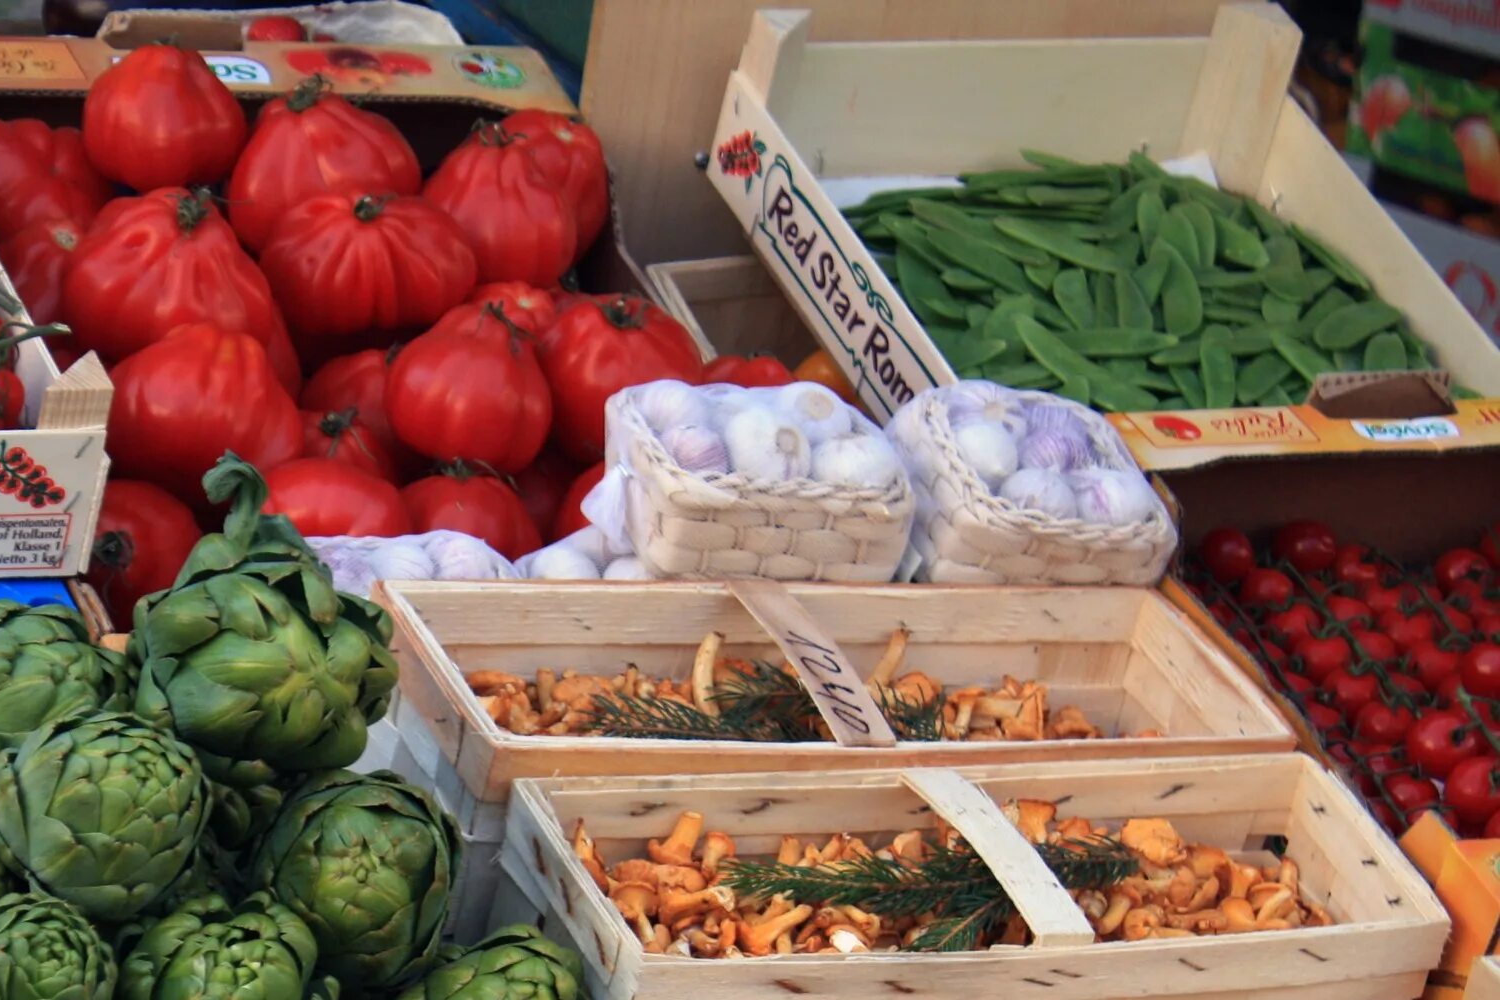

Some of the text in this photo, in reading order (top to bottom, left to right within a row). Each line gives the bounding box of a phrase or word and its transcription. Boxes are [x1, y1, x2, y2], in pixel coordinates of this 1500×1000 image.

[769, 185, 818, 268] Red
[811, 252, 865, 335] Star
[12, 528, 63, 540] Holland.
[13, 541, 51, 551] Klasse
[30, 554, 38, 563] 3
